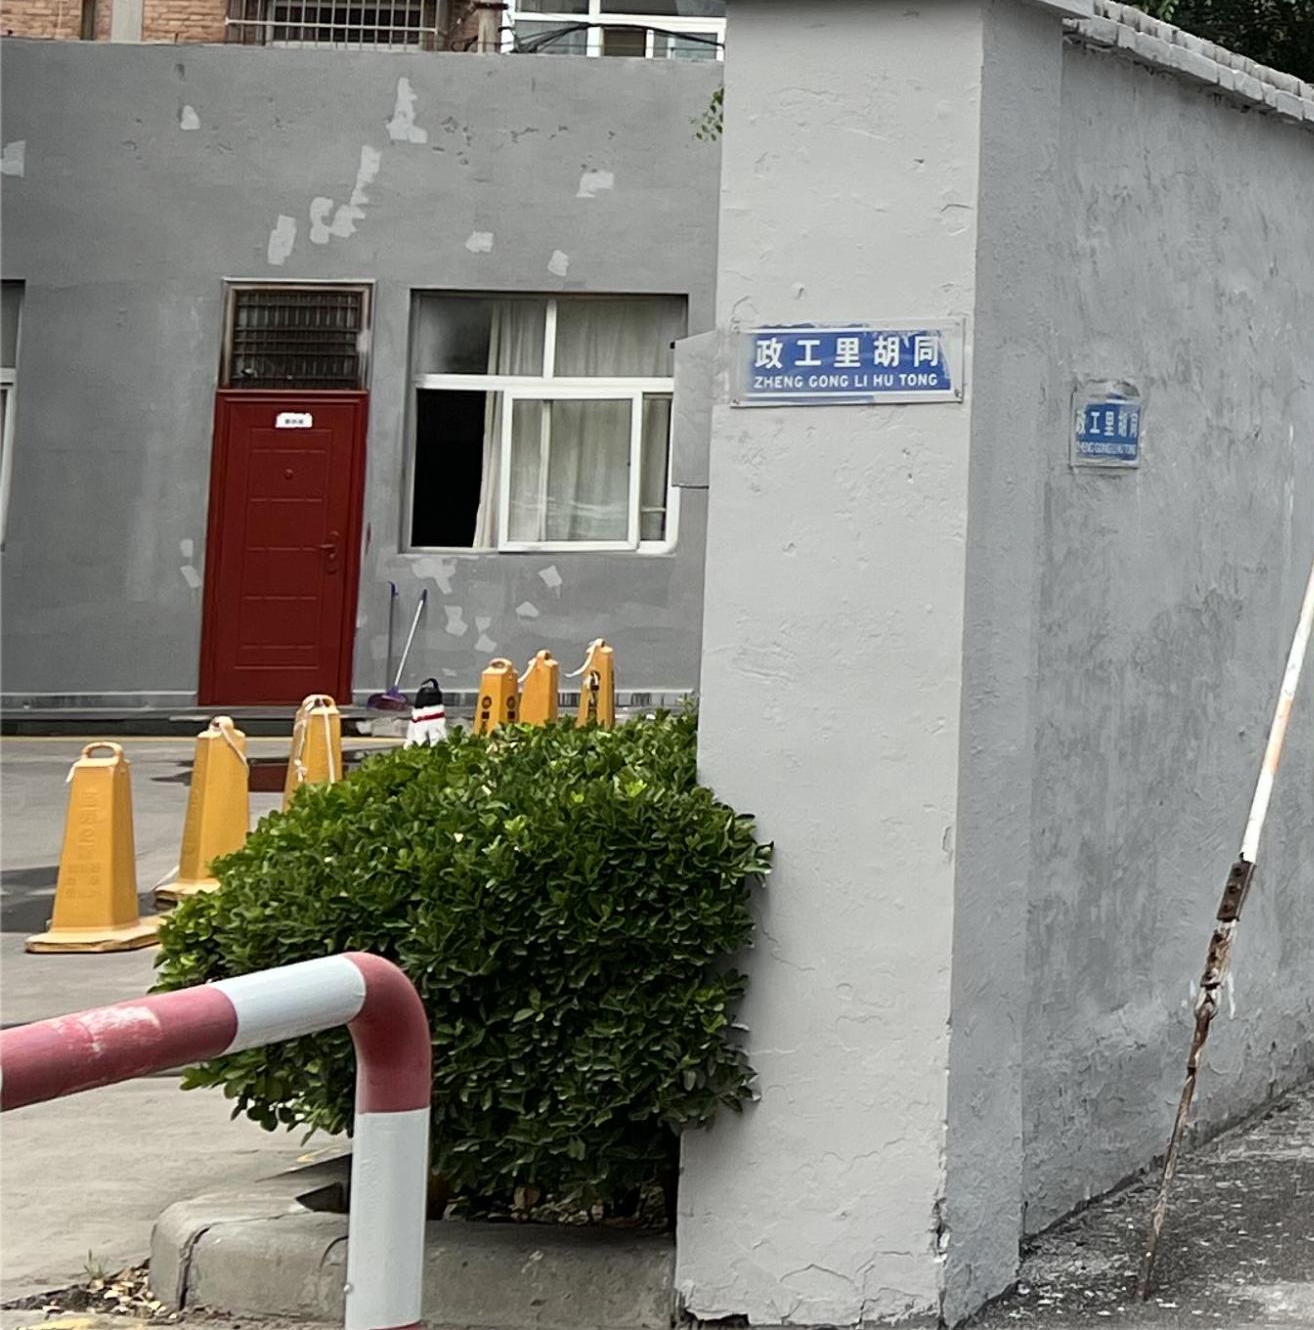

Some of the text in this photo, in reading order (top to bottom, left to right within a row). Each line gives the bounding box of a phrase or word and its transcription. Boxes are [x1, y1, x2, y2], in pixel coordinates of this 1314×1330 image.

[754, 336, 940, 369] 政工里胡同
[753, 373, 938, 389] ZHENG GONG LI HU TONG
